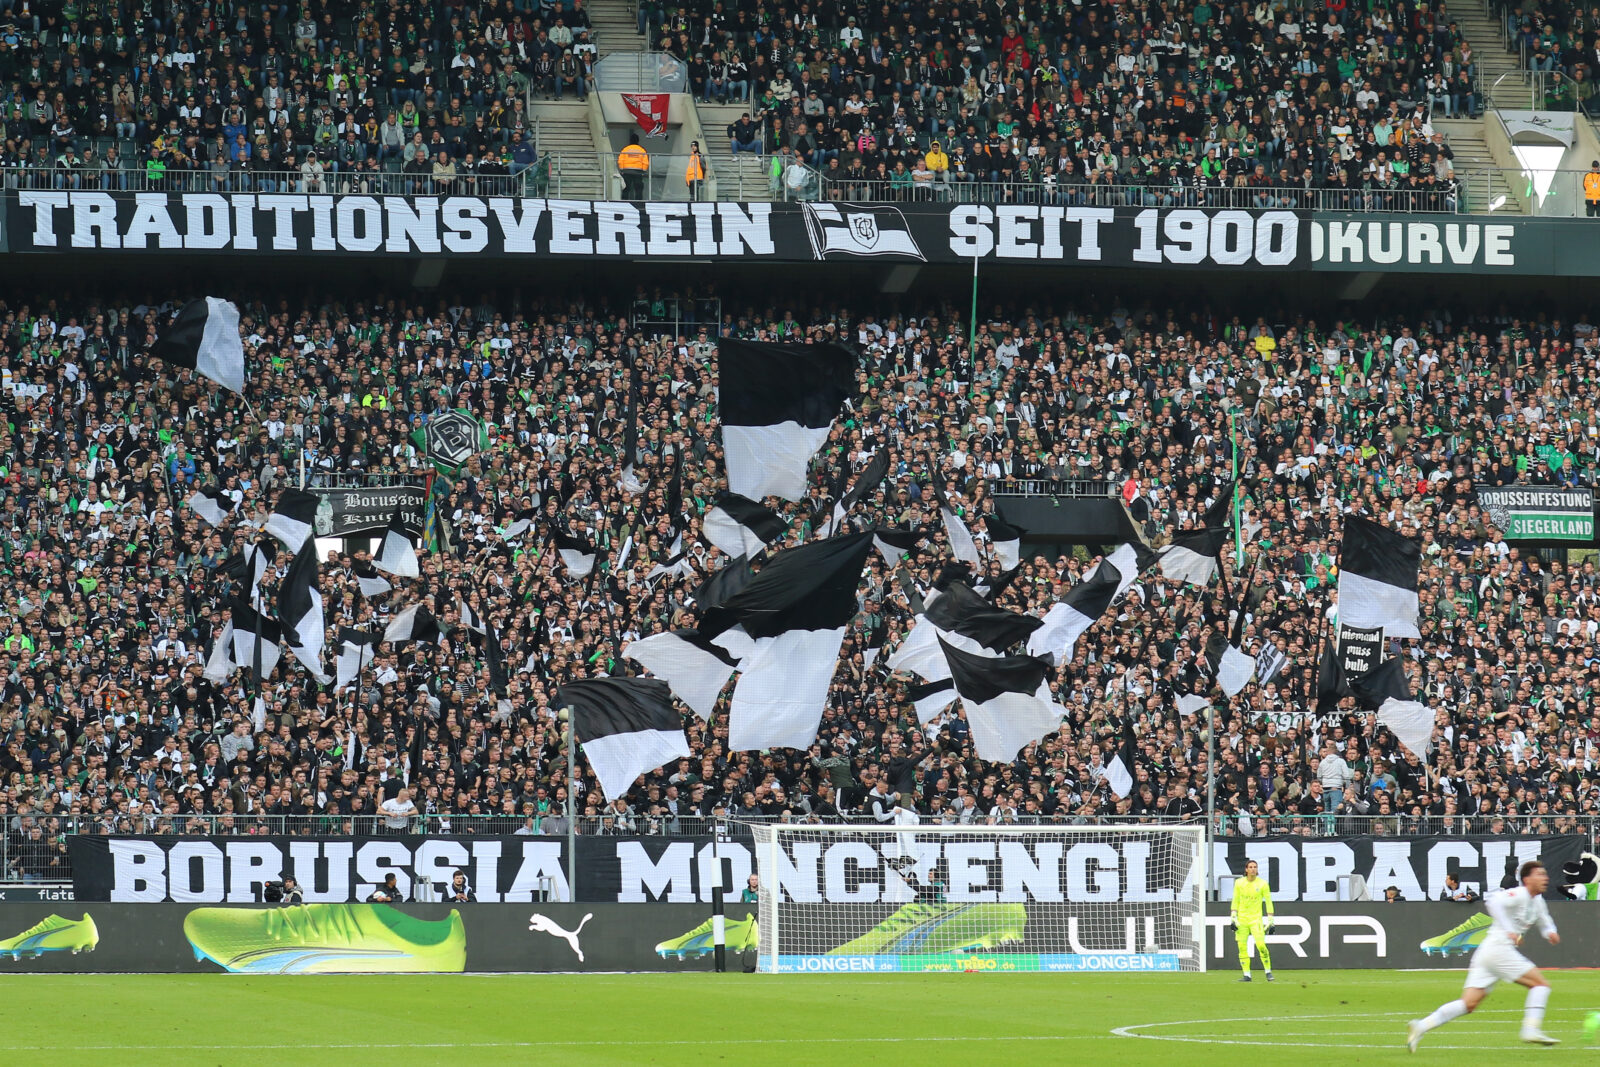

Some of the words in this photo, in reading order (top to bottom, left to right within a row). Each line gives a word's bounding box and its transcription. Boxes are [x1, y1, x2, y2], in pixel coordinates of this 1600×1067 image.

[19, 191, 775, 255] TRADITIONSVEREIN
[950, 205, 1114, 260] SEIT
[1133, 208, 1299, 265] 1900
[343, 493, 424, 510] Borussen
[1477, 491, 1591, 507] BORUSSENFESTUNG
[1513, 519, 1593, 535] SIEGERLAND
[1341, 629, 1380, 642] niemand
[1346, 645, 1371, 657] muss
[1344, 657, 1369, 672] bulle
[108, 840, 570, 903] BORUSSIA
[1068, 915, 1387, 958] ULTRA
[797, 957, 875, 971] JONGEN
[1078, 956, 1154, 970] JONGEN
